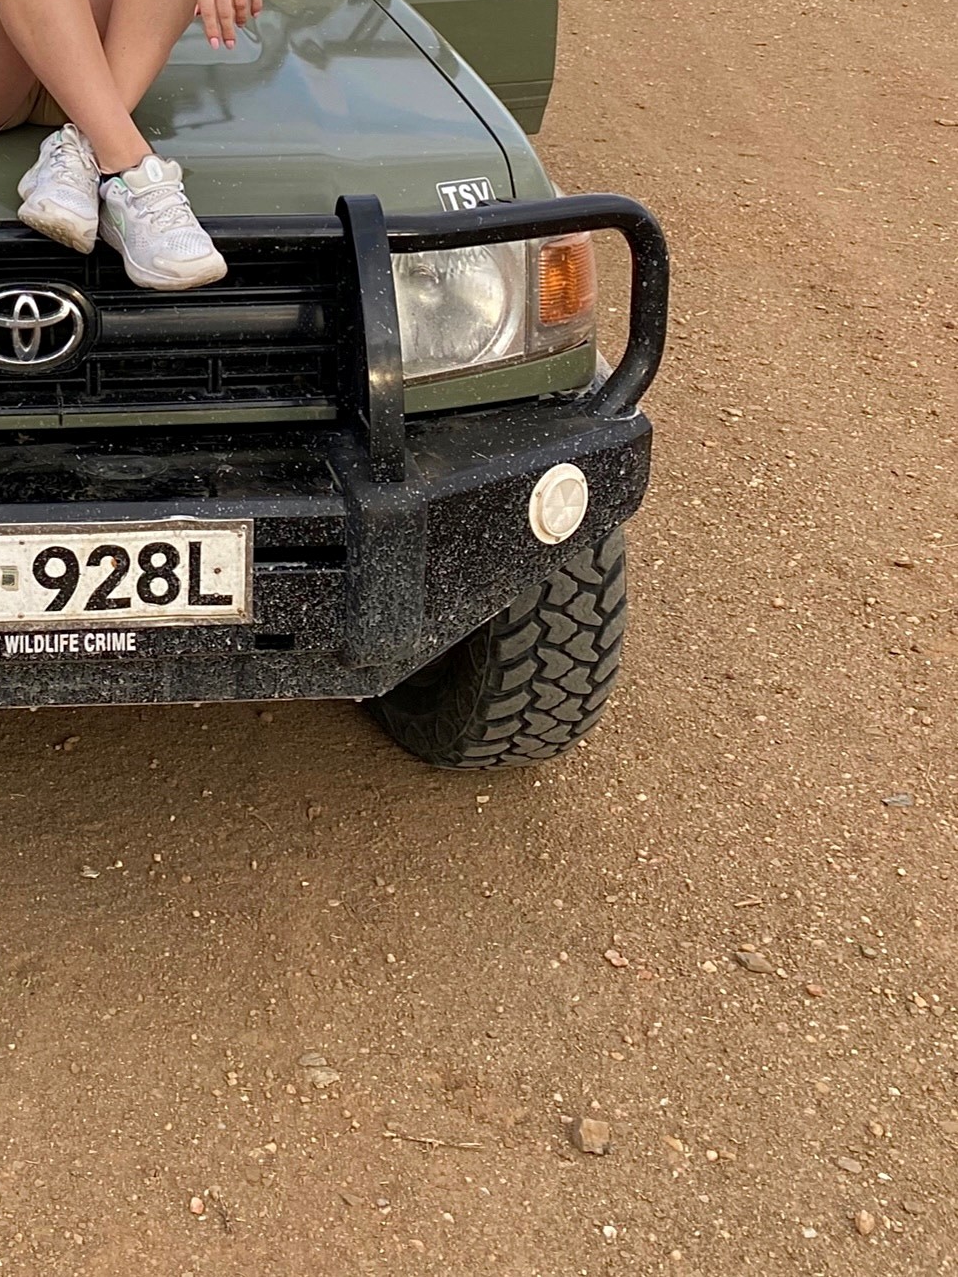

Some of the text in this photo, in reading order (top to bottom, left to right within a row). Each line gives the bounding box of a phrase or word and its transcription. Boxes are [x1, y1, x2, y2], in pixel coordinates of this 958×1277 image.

[442, 182, 489, 210] TSV
[32, 541, 233, 611] 928L
[4, 632, 79, 654] WILDLIFE
[84, 632, 137, 652] CRIME
